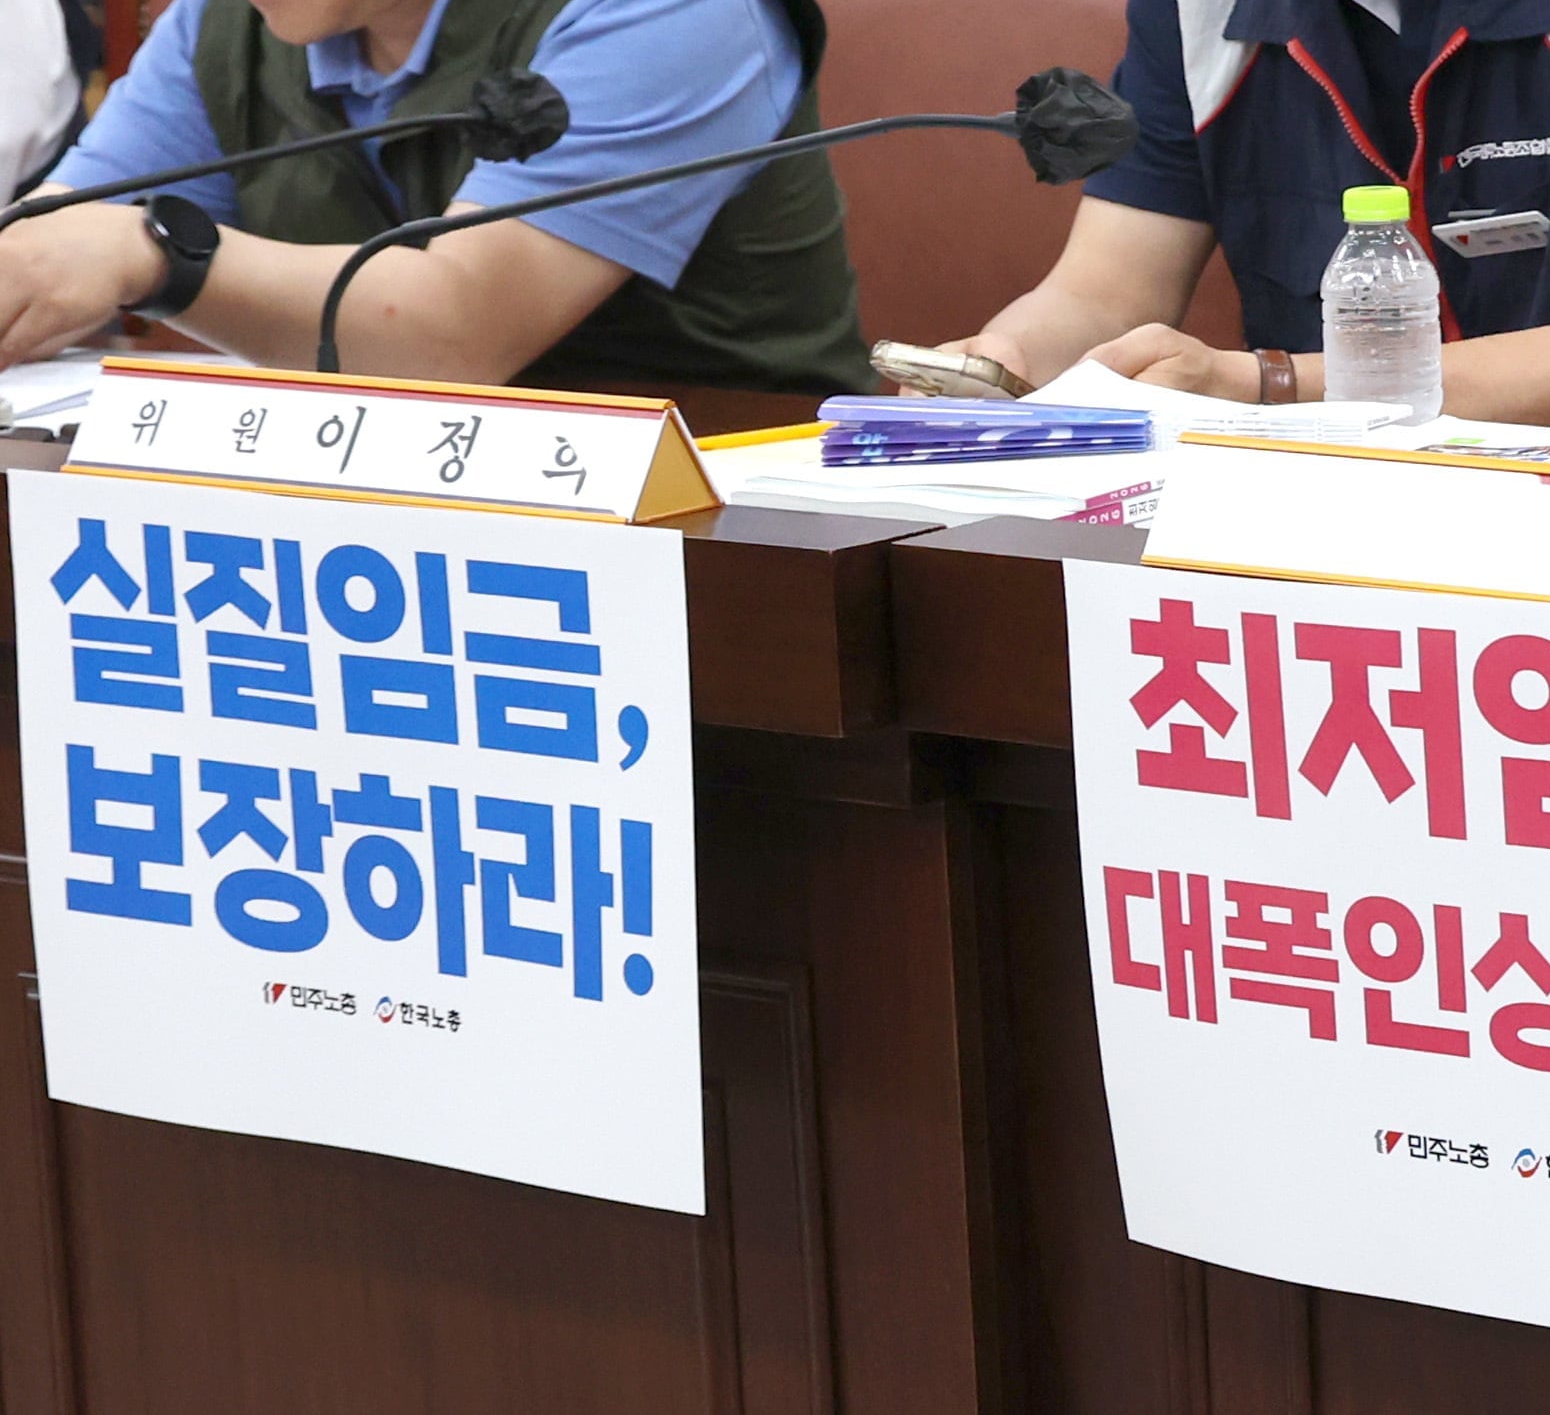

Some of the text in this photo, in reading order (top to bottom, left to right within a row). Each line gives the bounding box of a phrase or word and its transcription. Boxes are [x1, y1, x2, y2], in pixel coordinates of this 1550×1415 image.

[131, 398, 268, 455] 위원
[49, 517, 650, 772] 실질임금,
[65, 743, 656, 1002] 보장하라!
[290, 985, 462, 1033] 민주노총 한국노총
[1407, 1134, 1490, 1169] 민주노총
